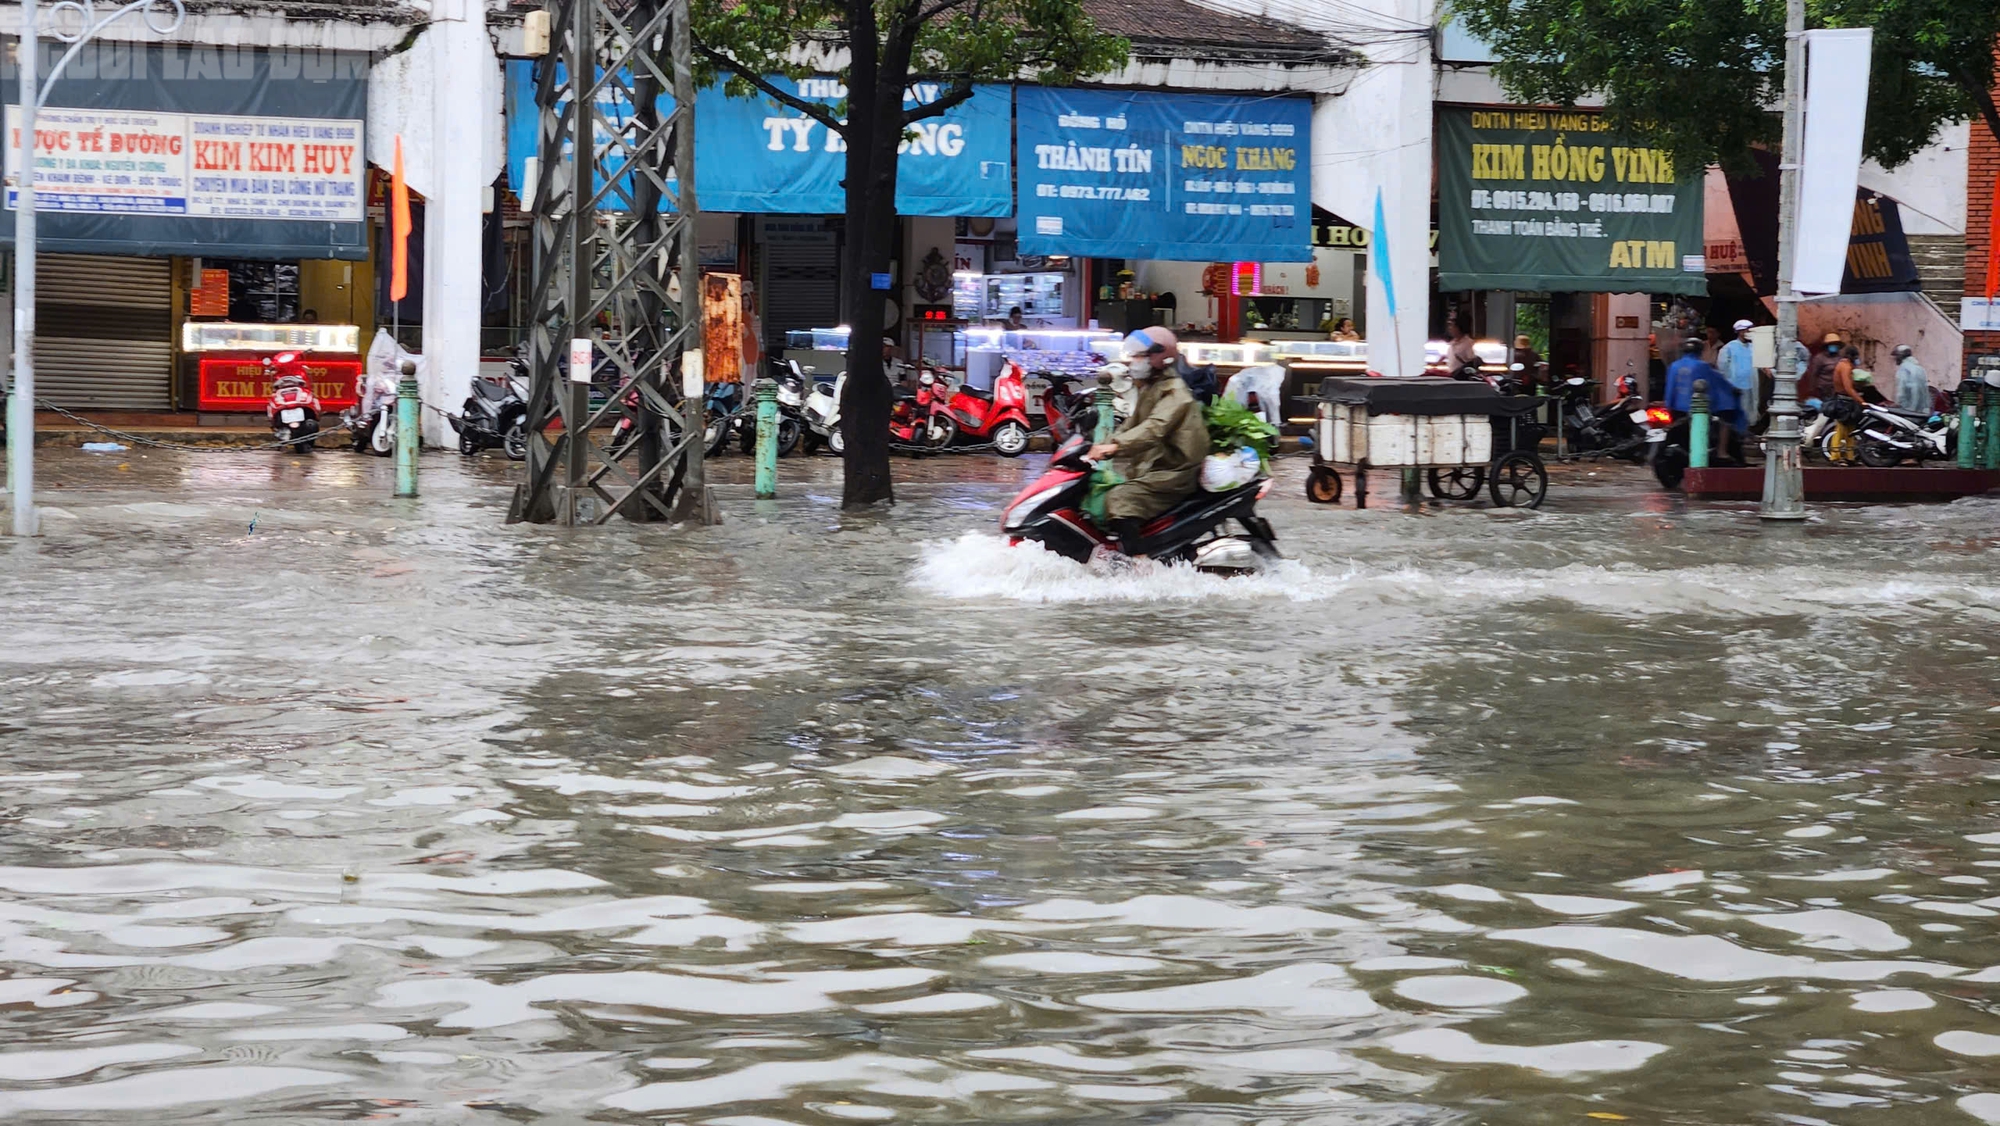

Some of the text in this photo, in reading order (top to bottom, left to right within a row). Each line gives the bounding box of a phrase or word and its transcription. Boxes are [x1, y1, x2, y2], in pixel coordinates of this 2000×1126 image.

[1471, 111, 1510, 129] DNTN
[13, 128, 71, 155] ƯỢC
[77, 125, 104, 152] TẾ
[194, 140, 355, 174] KIM KIM HUY
[1034, 140, 1153, 173] THÀNH TÍN
[1236, 147, 1296, 170] KHANG
[1471, 143, 1525, 179] KIM
[1531, 132, 1606, 182] HỒNG
[1609, 240, 1676, 269] ATM
[217, 381, 255, 398] KIM
